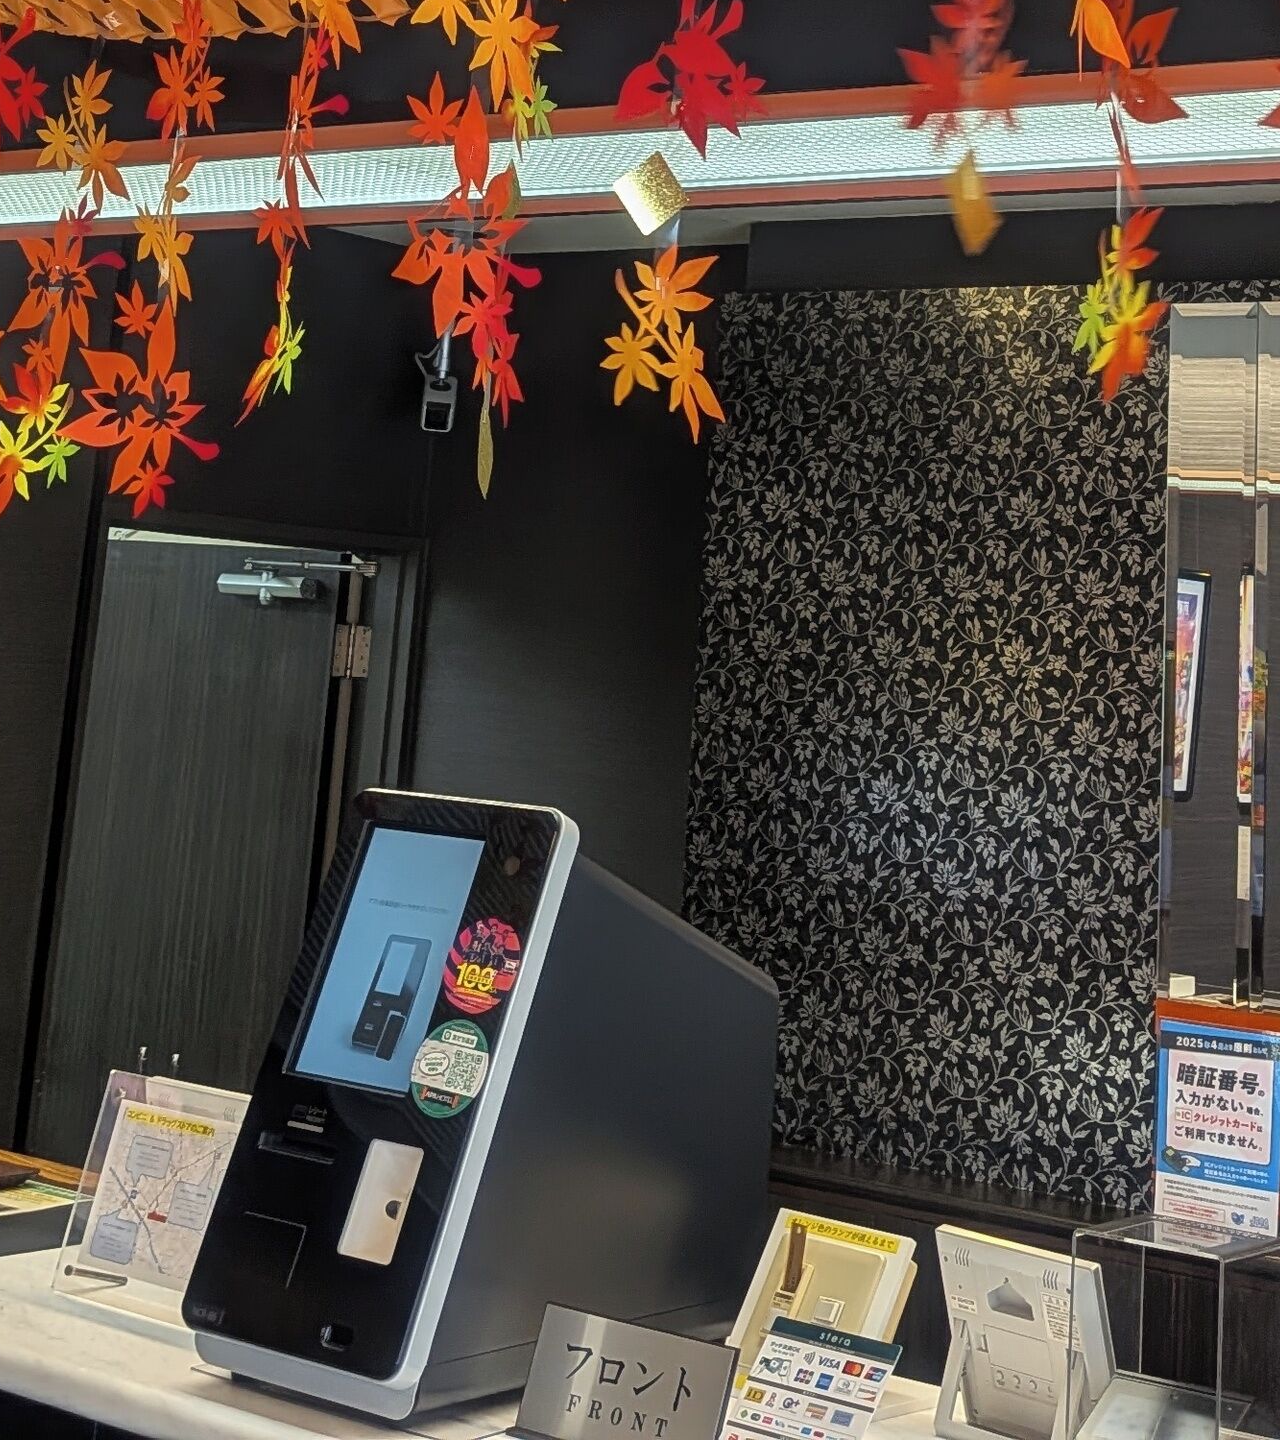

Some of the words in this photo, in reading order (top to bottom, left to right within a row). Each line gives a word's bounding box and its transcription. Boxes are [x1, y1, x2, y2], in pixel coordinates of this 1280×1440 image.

[1177, 1063, 1265, 1097] 暗証番号の
[1174, 1126, 1263, 1151] ご利用できません。
[566, 1343, 692, 1412] フロント
[818, 1355, 841, 1371] VISA
[566, 1394, 669, 1438] FRONT
